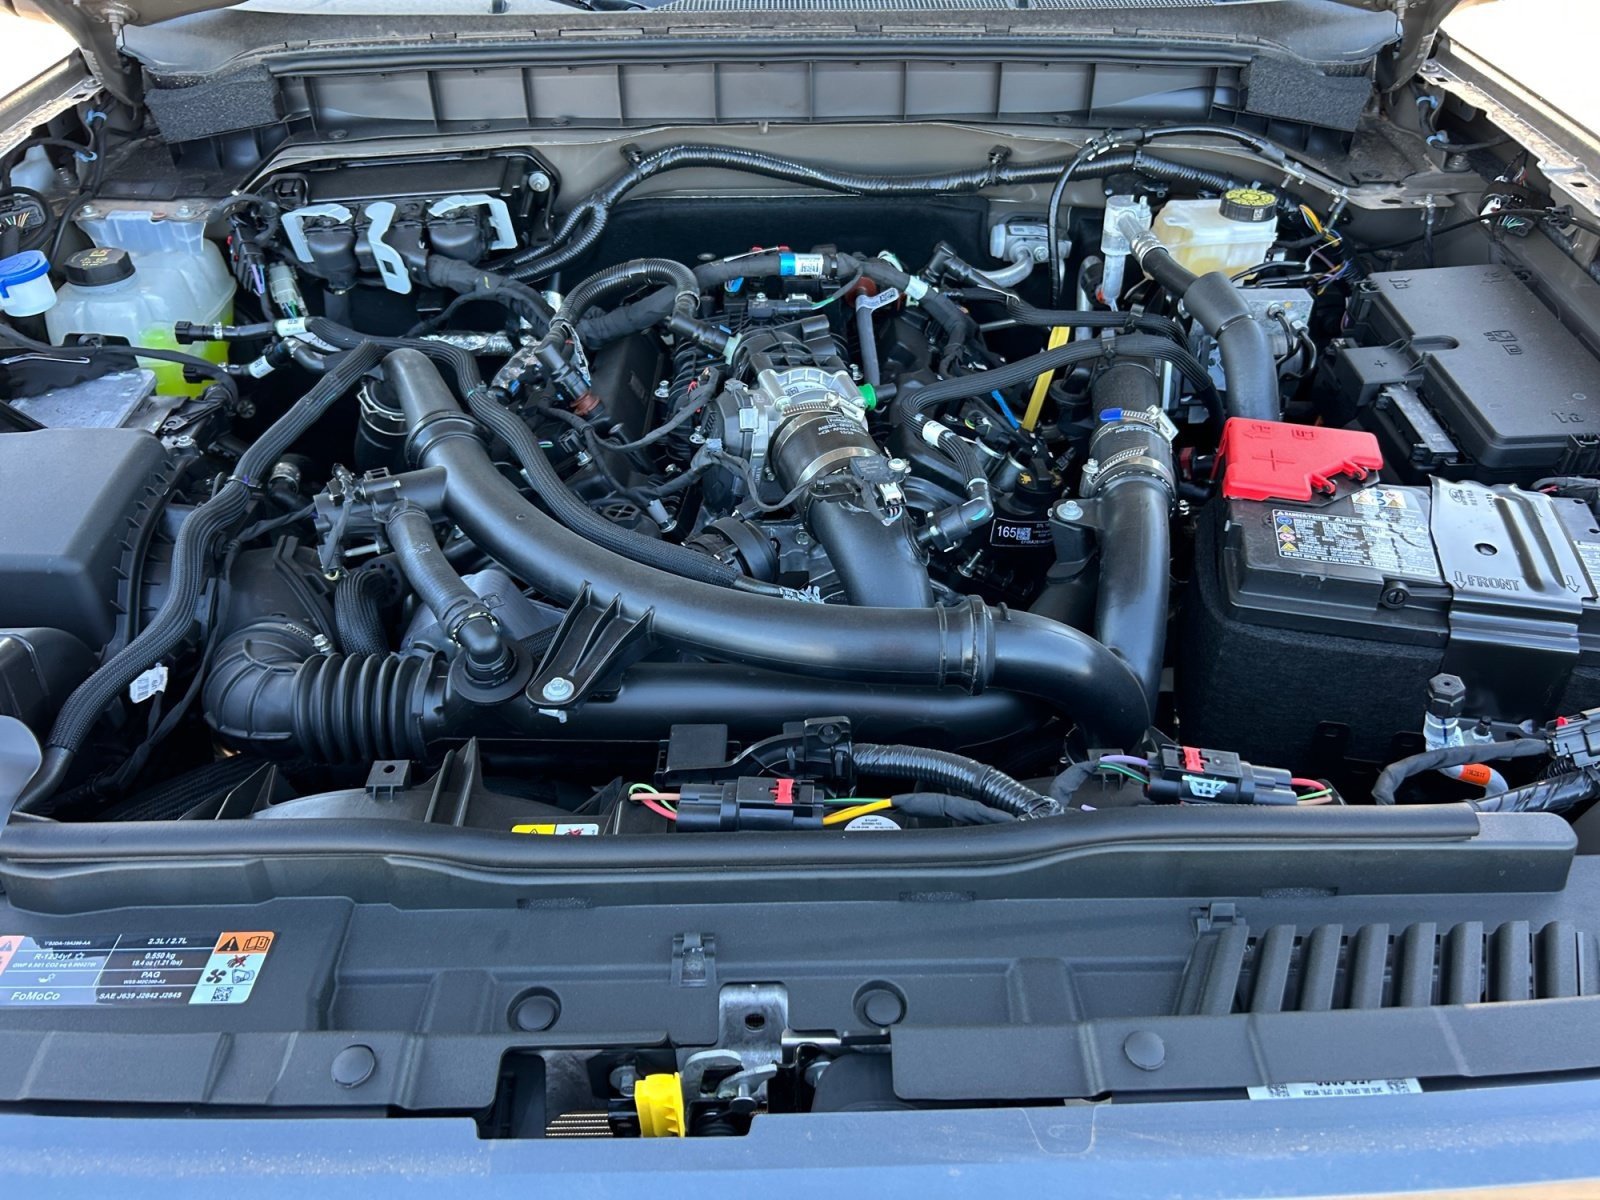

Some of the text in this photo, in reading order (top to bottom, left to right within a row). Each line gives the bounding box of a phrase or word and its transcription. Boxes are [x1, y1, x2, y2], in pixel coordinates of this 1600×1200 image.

[997, 525, 1017, 538] 165
[1467, 574, 1520, 592] FRONT
[33, 952, 73, 961] R-1234yf
[144, 952, 177, 960] 0.550 kg
[11, 991, 61, 1001] FoMoCo
[98, 992, 117, 1000] SAE
